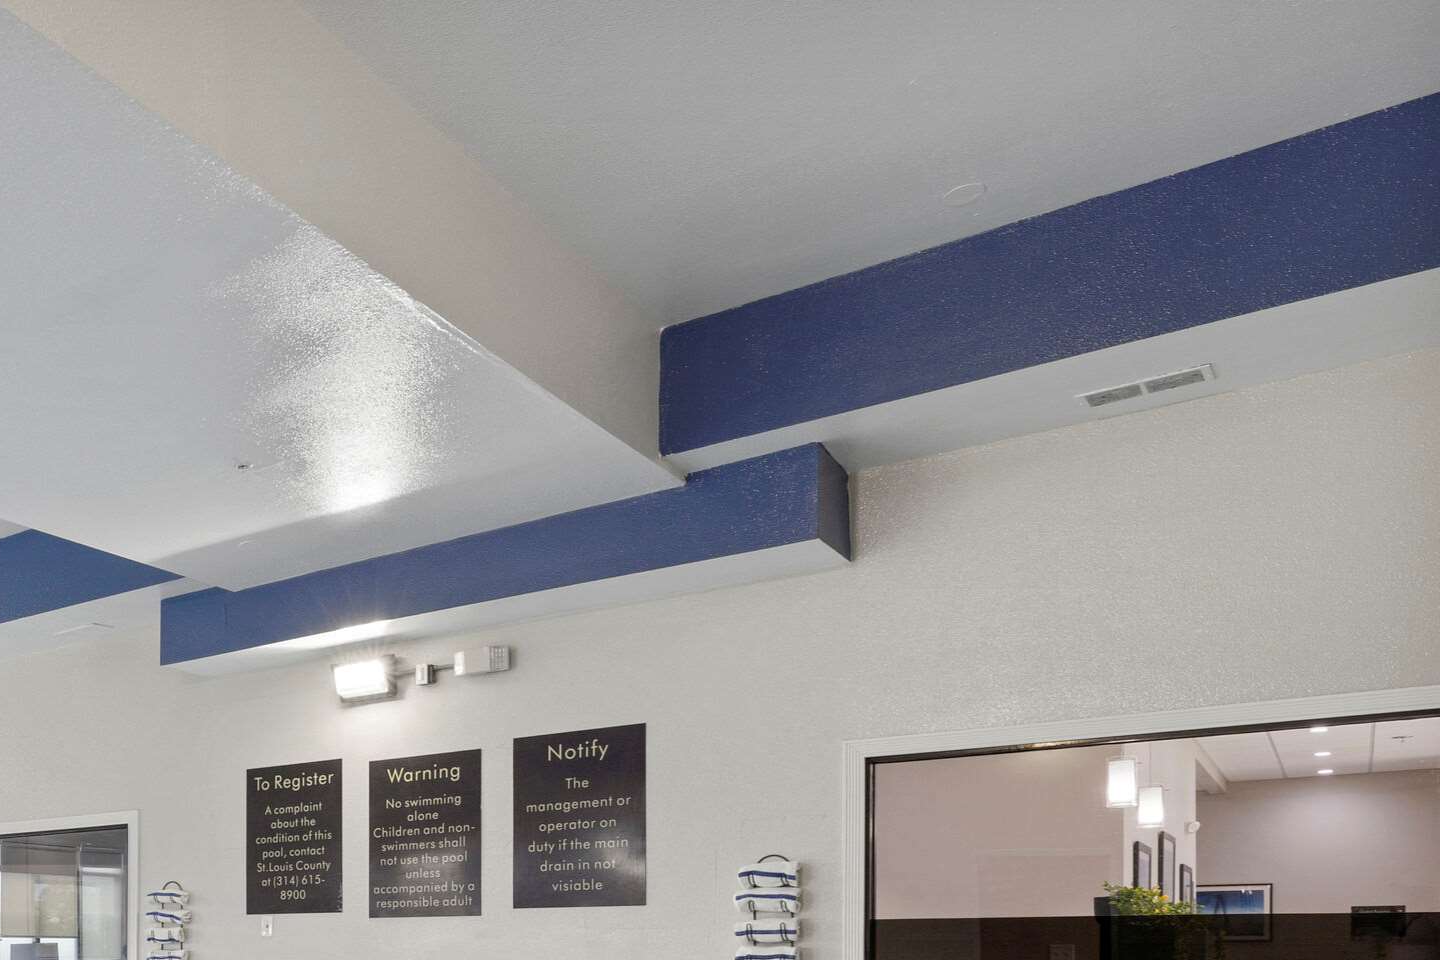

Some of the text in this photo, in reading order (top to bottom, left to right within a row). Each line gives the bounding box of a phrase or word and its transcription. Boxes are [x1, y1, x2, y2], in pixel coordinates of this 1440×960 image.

[548, 739, 609, 761] Notify
[386, 763, 461, 784] Warning
[254, 772, 335, 791] To Register
[565, 777, 589, 789] The
[385, 793, 462, 809] No swimming
[526, 796, 631, 813] management or
[264, 802, 322, 815] A complaint
[407, 810, 439, 821] alone
[270, 817, 316, 829] about the
[539, 819, 617, 834] operator on
[255, 829, 332, 844] condition of this
[373, 823, 476, 838] Children and non-
[381, 836, 466, 852] swimmers shall
[528, 836, 629, 854] duty if the main
[262, 846, 325, 860] pool, contact
[380, 850, 468, 866] not use the pool
[295, 860, 331, 871] County
[540, 859, 616, 872] drain in not
[405, 868, 441, 879] unless
[261, 874, 326, 888] at (314) 615-
[373, 880, 475, 895] accompanied by a
[551, 879, 603, 892] visiable
[280, 890, 306, 900] 8900
[376, 895, 473, 909] responsible adult
